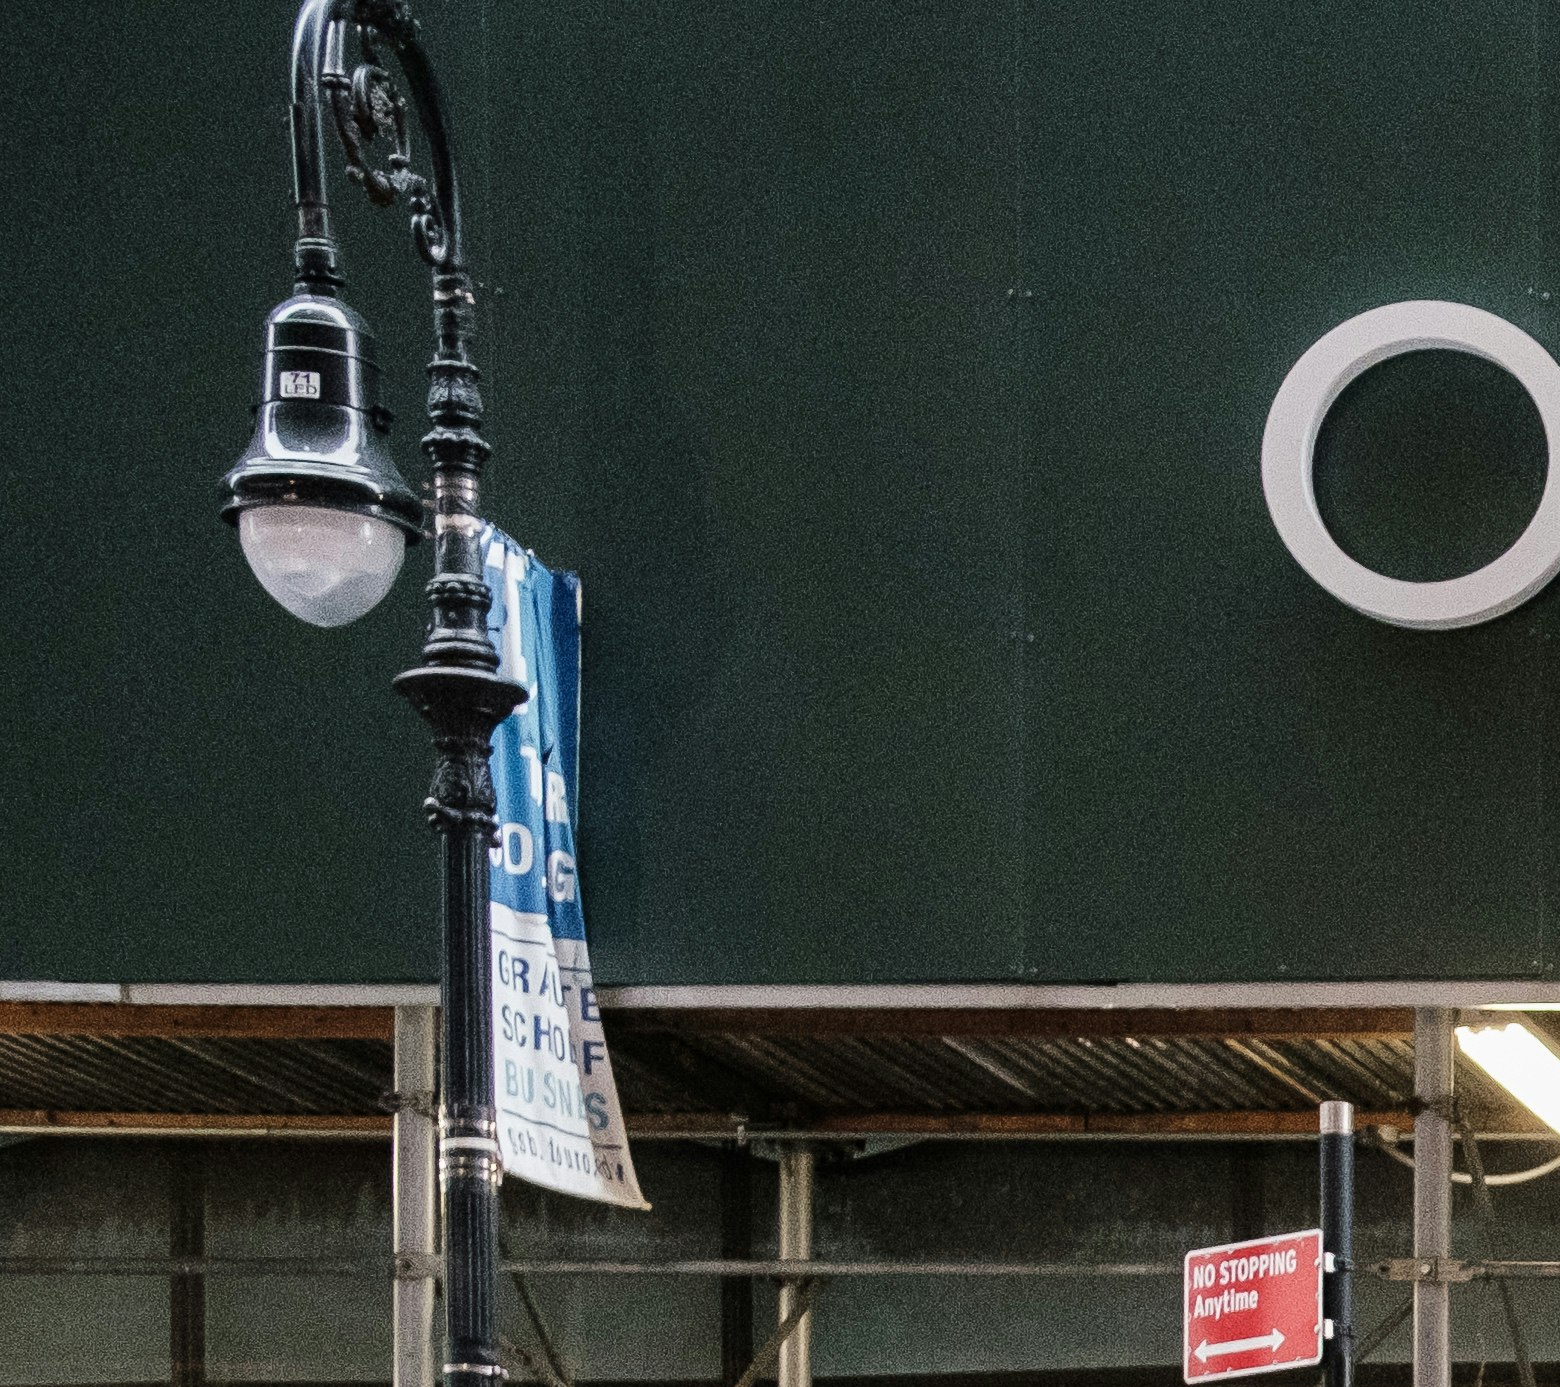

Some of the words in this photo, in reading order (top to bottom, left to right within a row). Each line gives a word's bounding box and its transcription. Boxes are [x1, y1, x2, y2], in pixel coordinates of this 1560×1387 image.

[290, 372, 310, 384] 71
[1193, 1264, 1216, 1290] NO
[1219, 1249, 1297, 1285] STOPPING
[1194, 1288, 1259, 1320] Anytime
